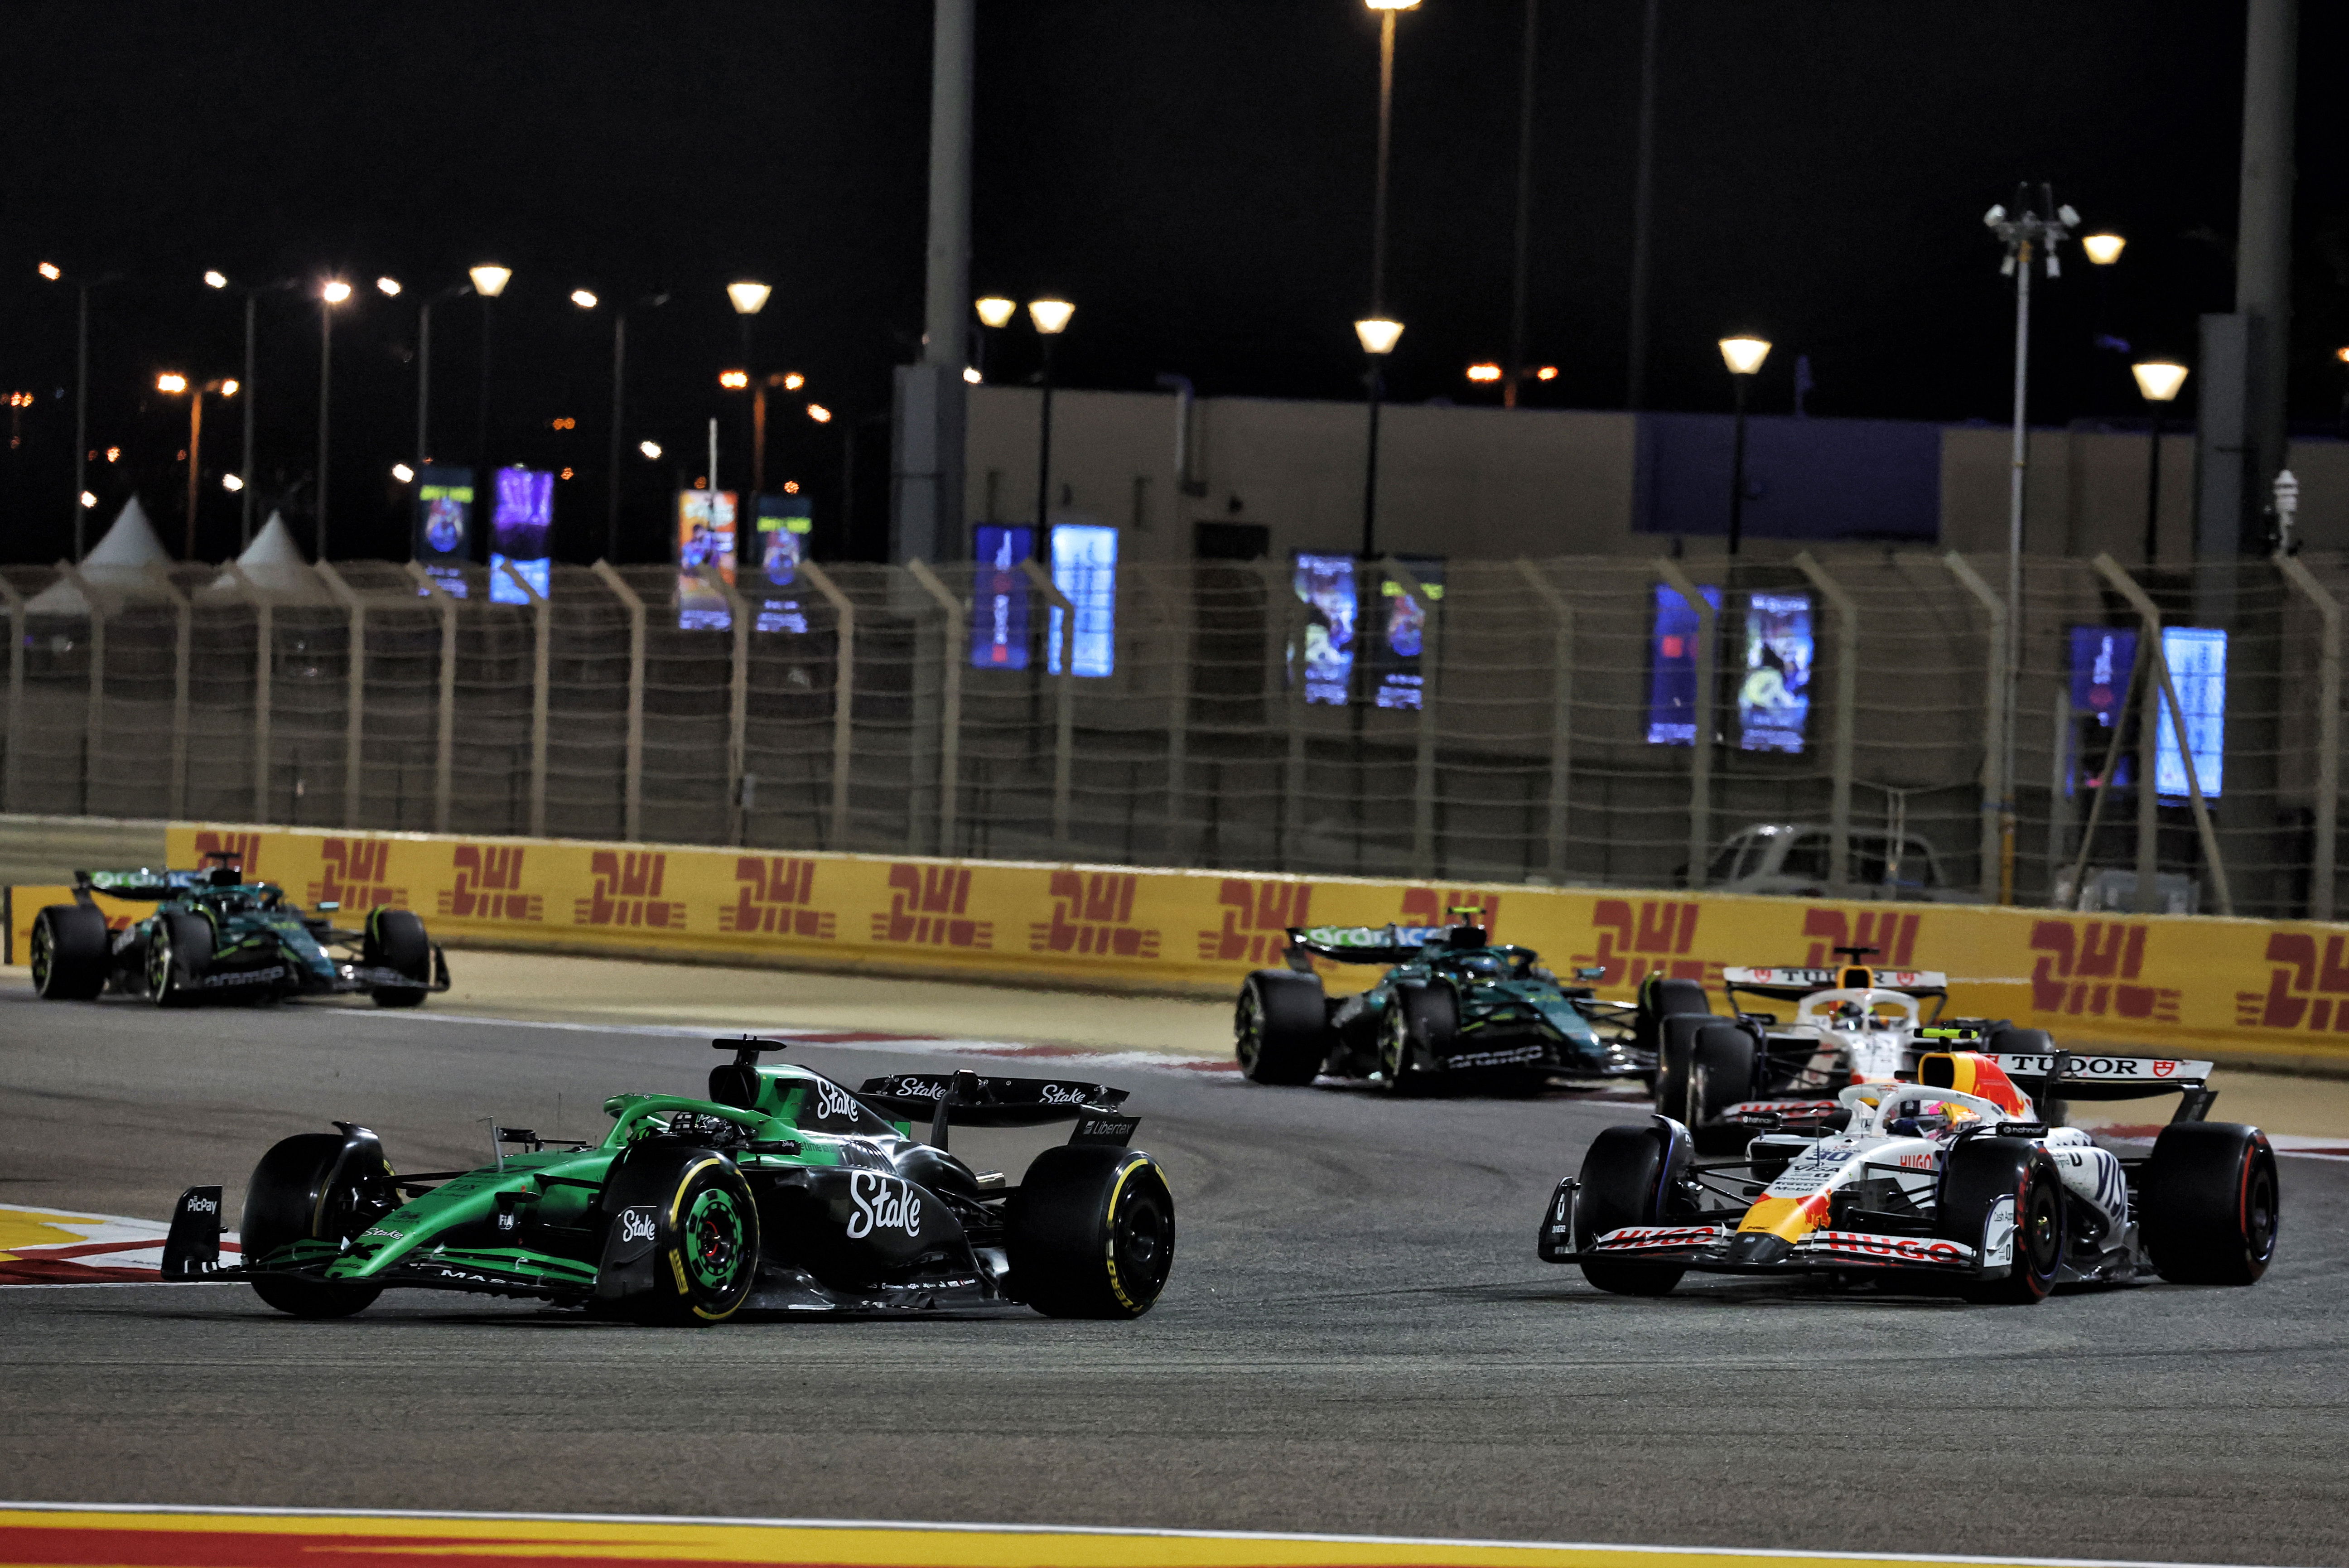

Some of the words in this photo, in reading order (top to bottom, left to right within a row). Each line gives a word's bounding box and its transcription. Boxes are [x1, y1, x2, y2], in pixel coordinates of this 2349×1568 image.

[321, 839, 394, 908] DHL
[453, 846, 529, 918] DHL
[590, 852, 670, 926] DHL
[735, 857, 820, 936] DHL
[888, 864, 977, 946] DHL
[1048, 872, 1143, 955] DHL
[1593, 900, 1707, 987] DHL
[2031, 920, 2159, 1020] DHL
[2011, 1056, 2137, 1075] TUDOR
[817, 1079, 859, 1122] Stake
[896, 1077, 946, 1100] Stake
[1039, 1084, 1086, 1104] Stake
[1092, 1120, 1133, 1135] Libertex
[1805, 1151, 1853, 1162] 30
[1900, 1153, 1932, 1169] HUGO
[187, 1198, 217, 1215] PicPay
[499, 1214, 513, 1226] FIA
[846, 1170, 920, 1239] Stake
[359, 1227, 404, 1240] Stake
[622, 1209, 656, 1243] Stake
[1606, 1227, 1714, 1249] HUGO
[1828, 1232, 1960, 1263] HUGO
